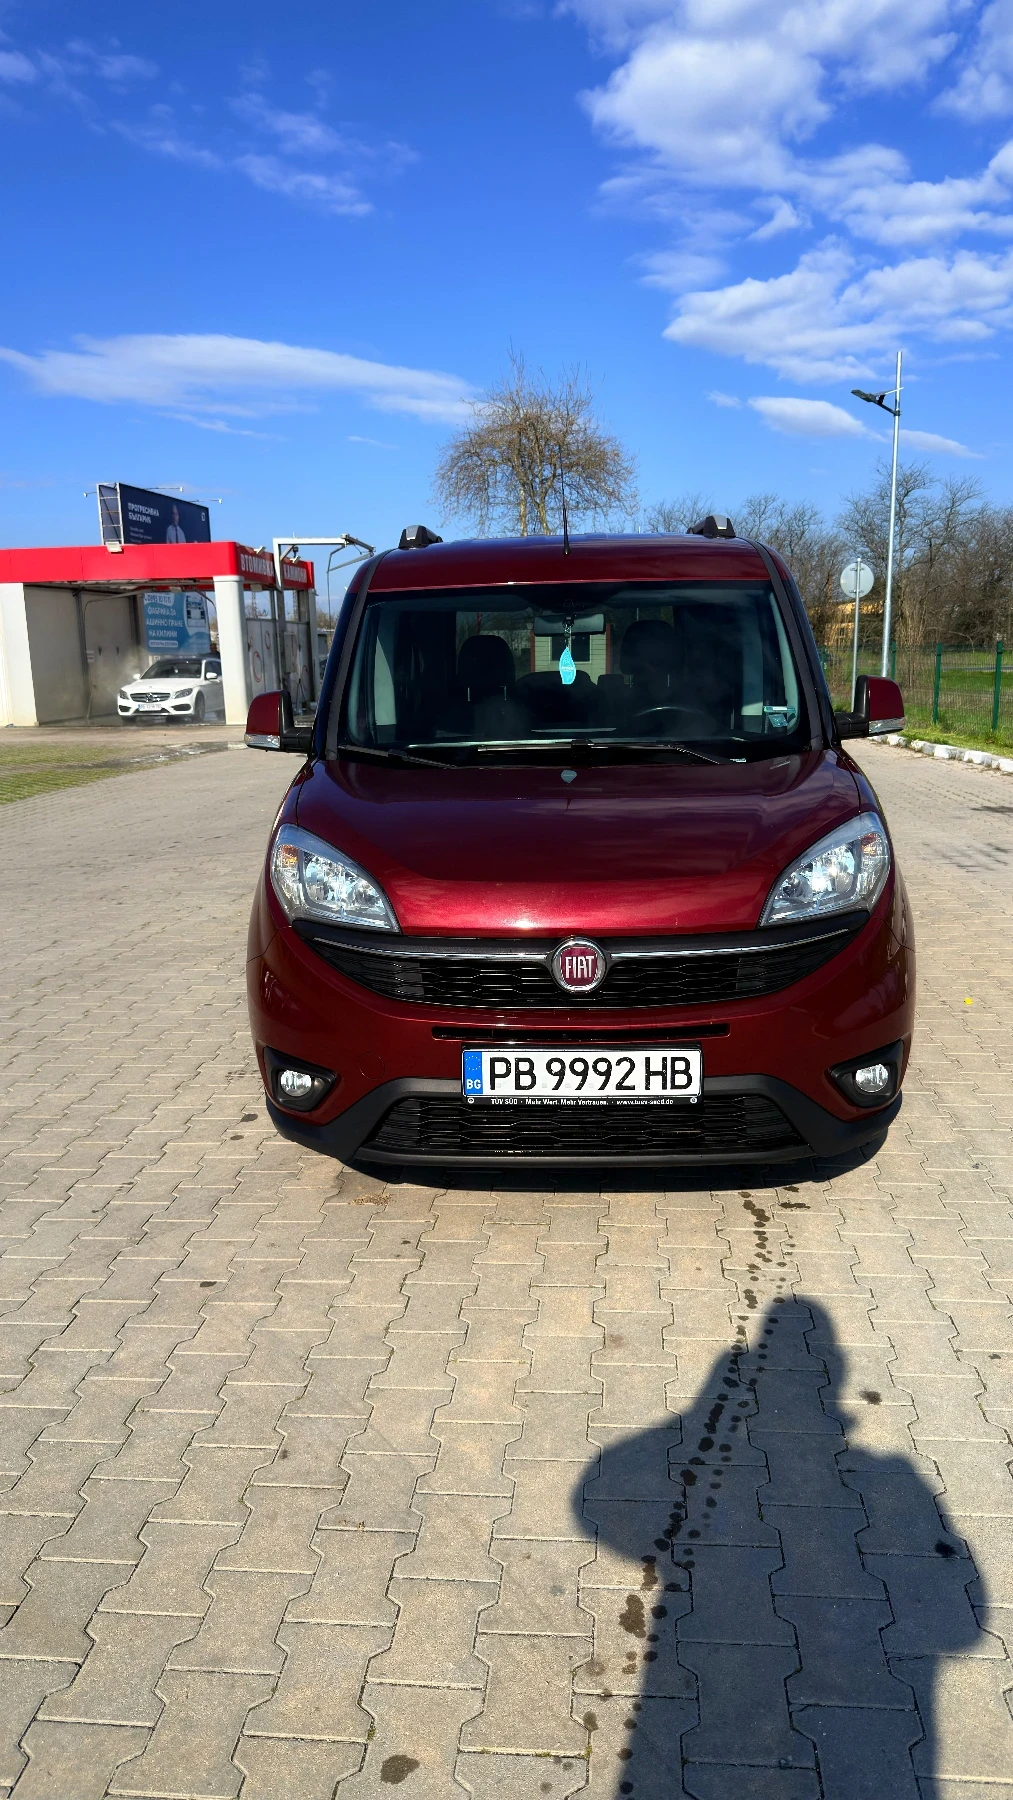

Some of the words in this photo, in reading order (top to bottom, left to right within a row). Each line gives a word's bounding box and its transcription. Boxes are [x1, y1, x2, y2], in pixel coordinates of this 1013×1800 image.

[128, 502, 159, 517] ПРОГРЕСИВНА
[146, 618, 168, 626] АШИННО
[565, 955, 595, 978] FIAT
[489, 1056, 537, 1091] PB
[546, 1056, 636, 1091] 9992
[644, 1056, 693, 1090] HB
[466, 1078, 482, 1090] BG
[491, 1097, 503, 1105] TÜV
[505, 1097, 518, 1105] SÜD
